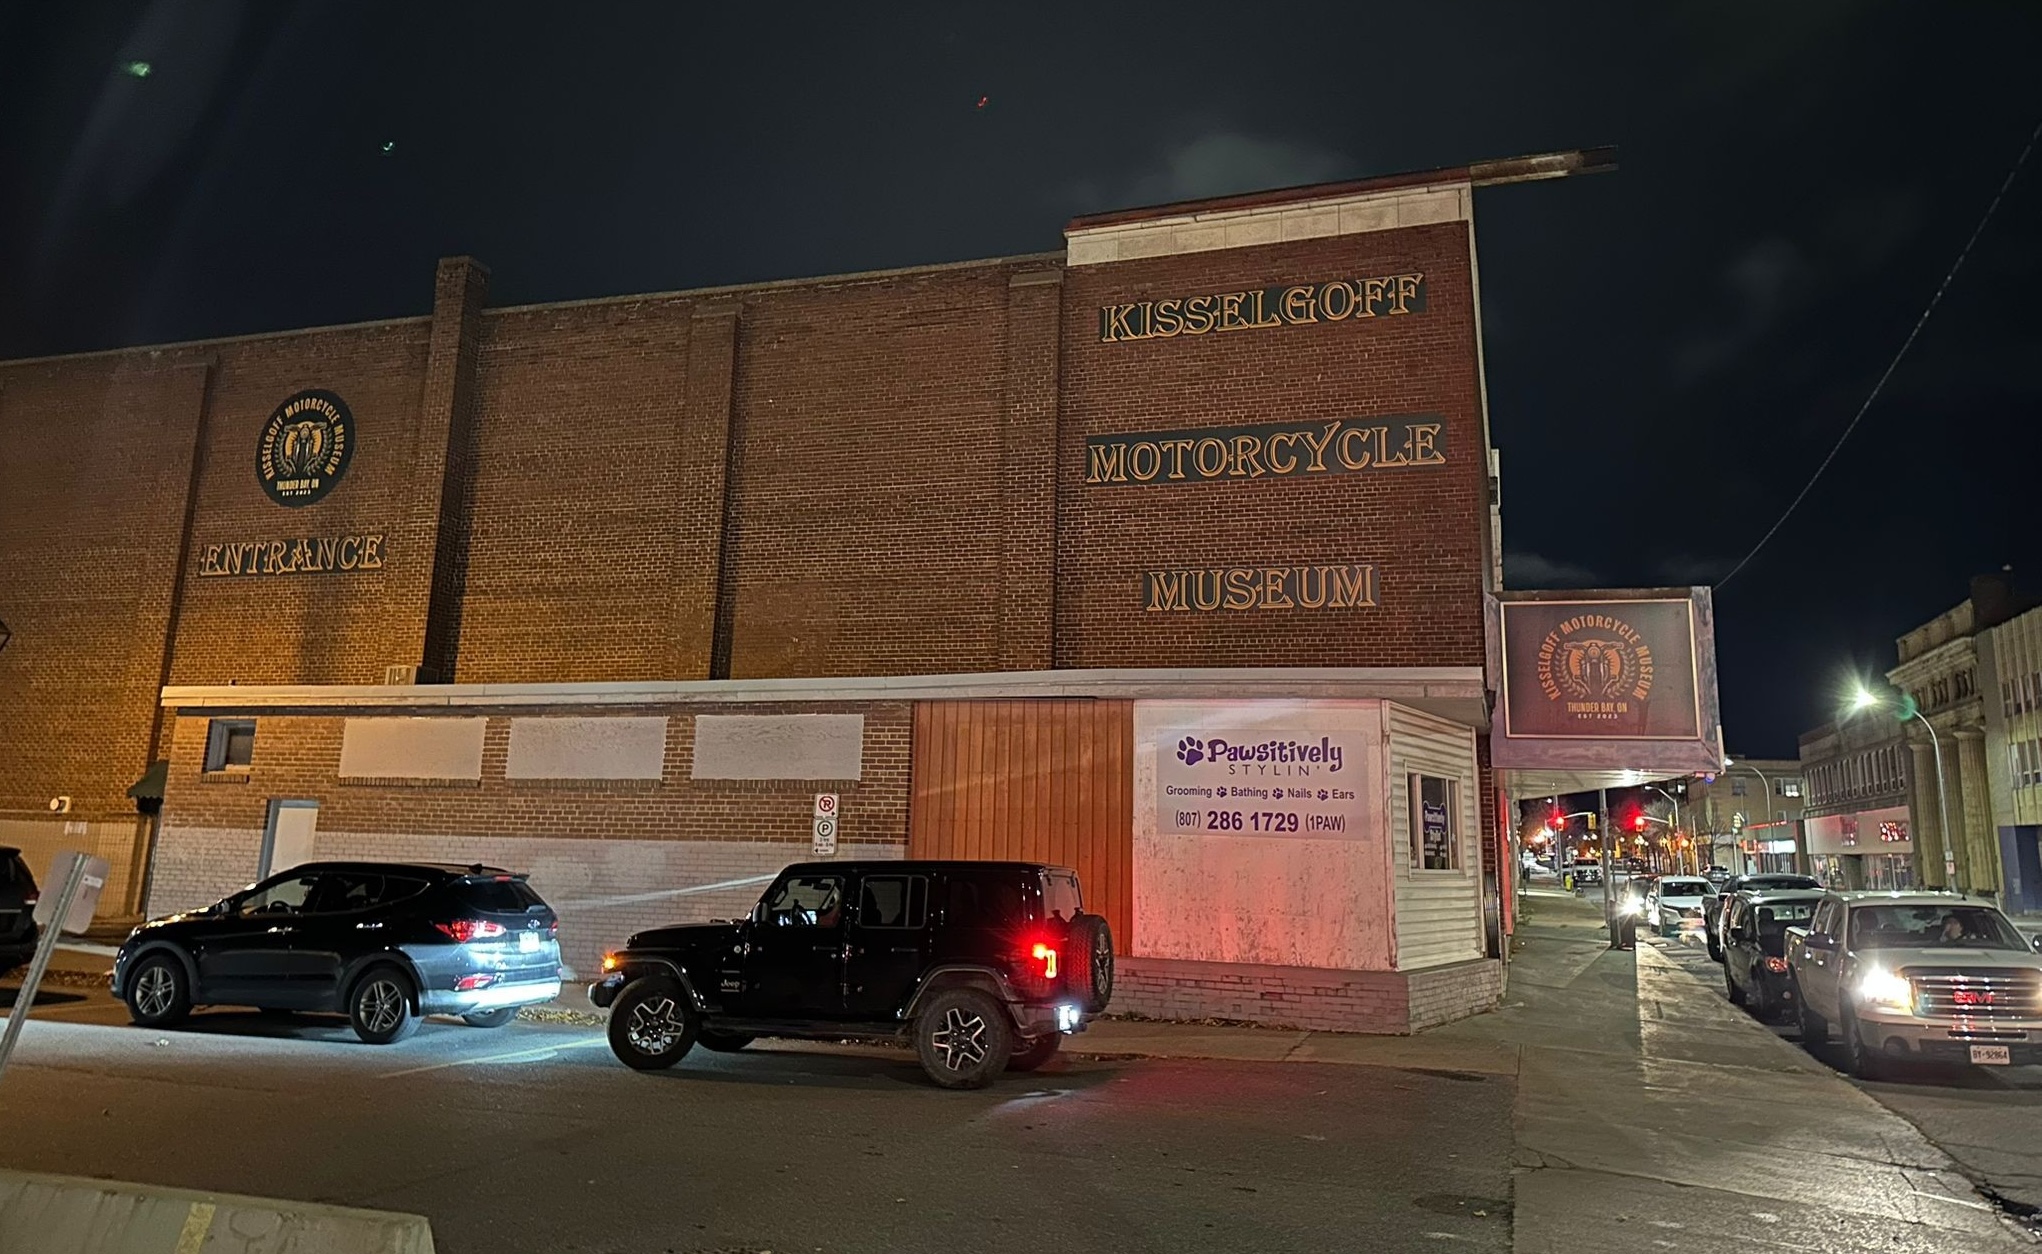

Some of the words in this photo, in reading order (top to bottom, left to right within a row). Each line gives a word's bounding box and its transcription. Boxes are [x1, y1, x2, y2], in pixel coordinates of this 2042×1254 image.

[1101, 273, 1424, 343] KISSELGOFF
[262, 416, 284, 480] KISSELGOFF
[285, 398, 340, 423] MOTORCYCLE
[324, 424, 345, 476] MUSEUM
[1086, 421, 1446, 483] MOTORCYCLE
[200, 534, 384, 576] ENTRANCE
[1146, 565, 1376, 612] MUSEUM
[1538, 631, 1561, 700] KISSELGOFF
[1560, 615, 1641, 645] MOTORCYCLE
[1632, 645, 1654, 700] MUSEUM
[1567, 702, 1599, 712] THUNDER
[1617, 702, 1627, 713] ON
[1207, 737, 1343, 772] Pawsitively
[1228, 764, 1321, 776] STYLIN'
[1166, 785, 1212, 798] Grooming
[1231, 787, 1268, 800] Bathing
[1287, 788, 1312, 799] Nails
[1332, 789, 1355, 800] Ears
[1175, 810, 1201, 828] (807)
[1207, 811, 1243, 830] 286
[1250, 812, 1299, 832] 1729
[1305, 814, 1346, 833] (1PAW)
[720, 979, 740, 990] Jeep
